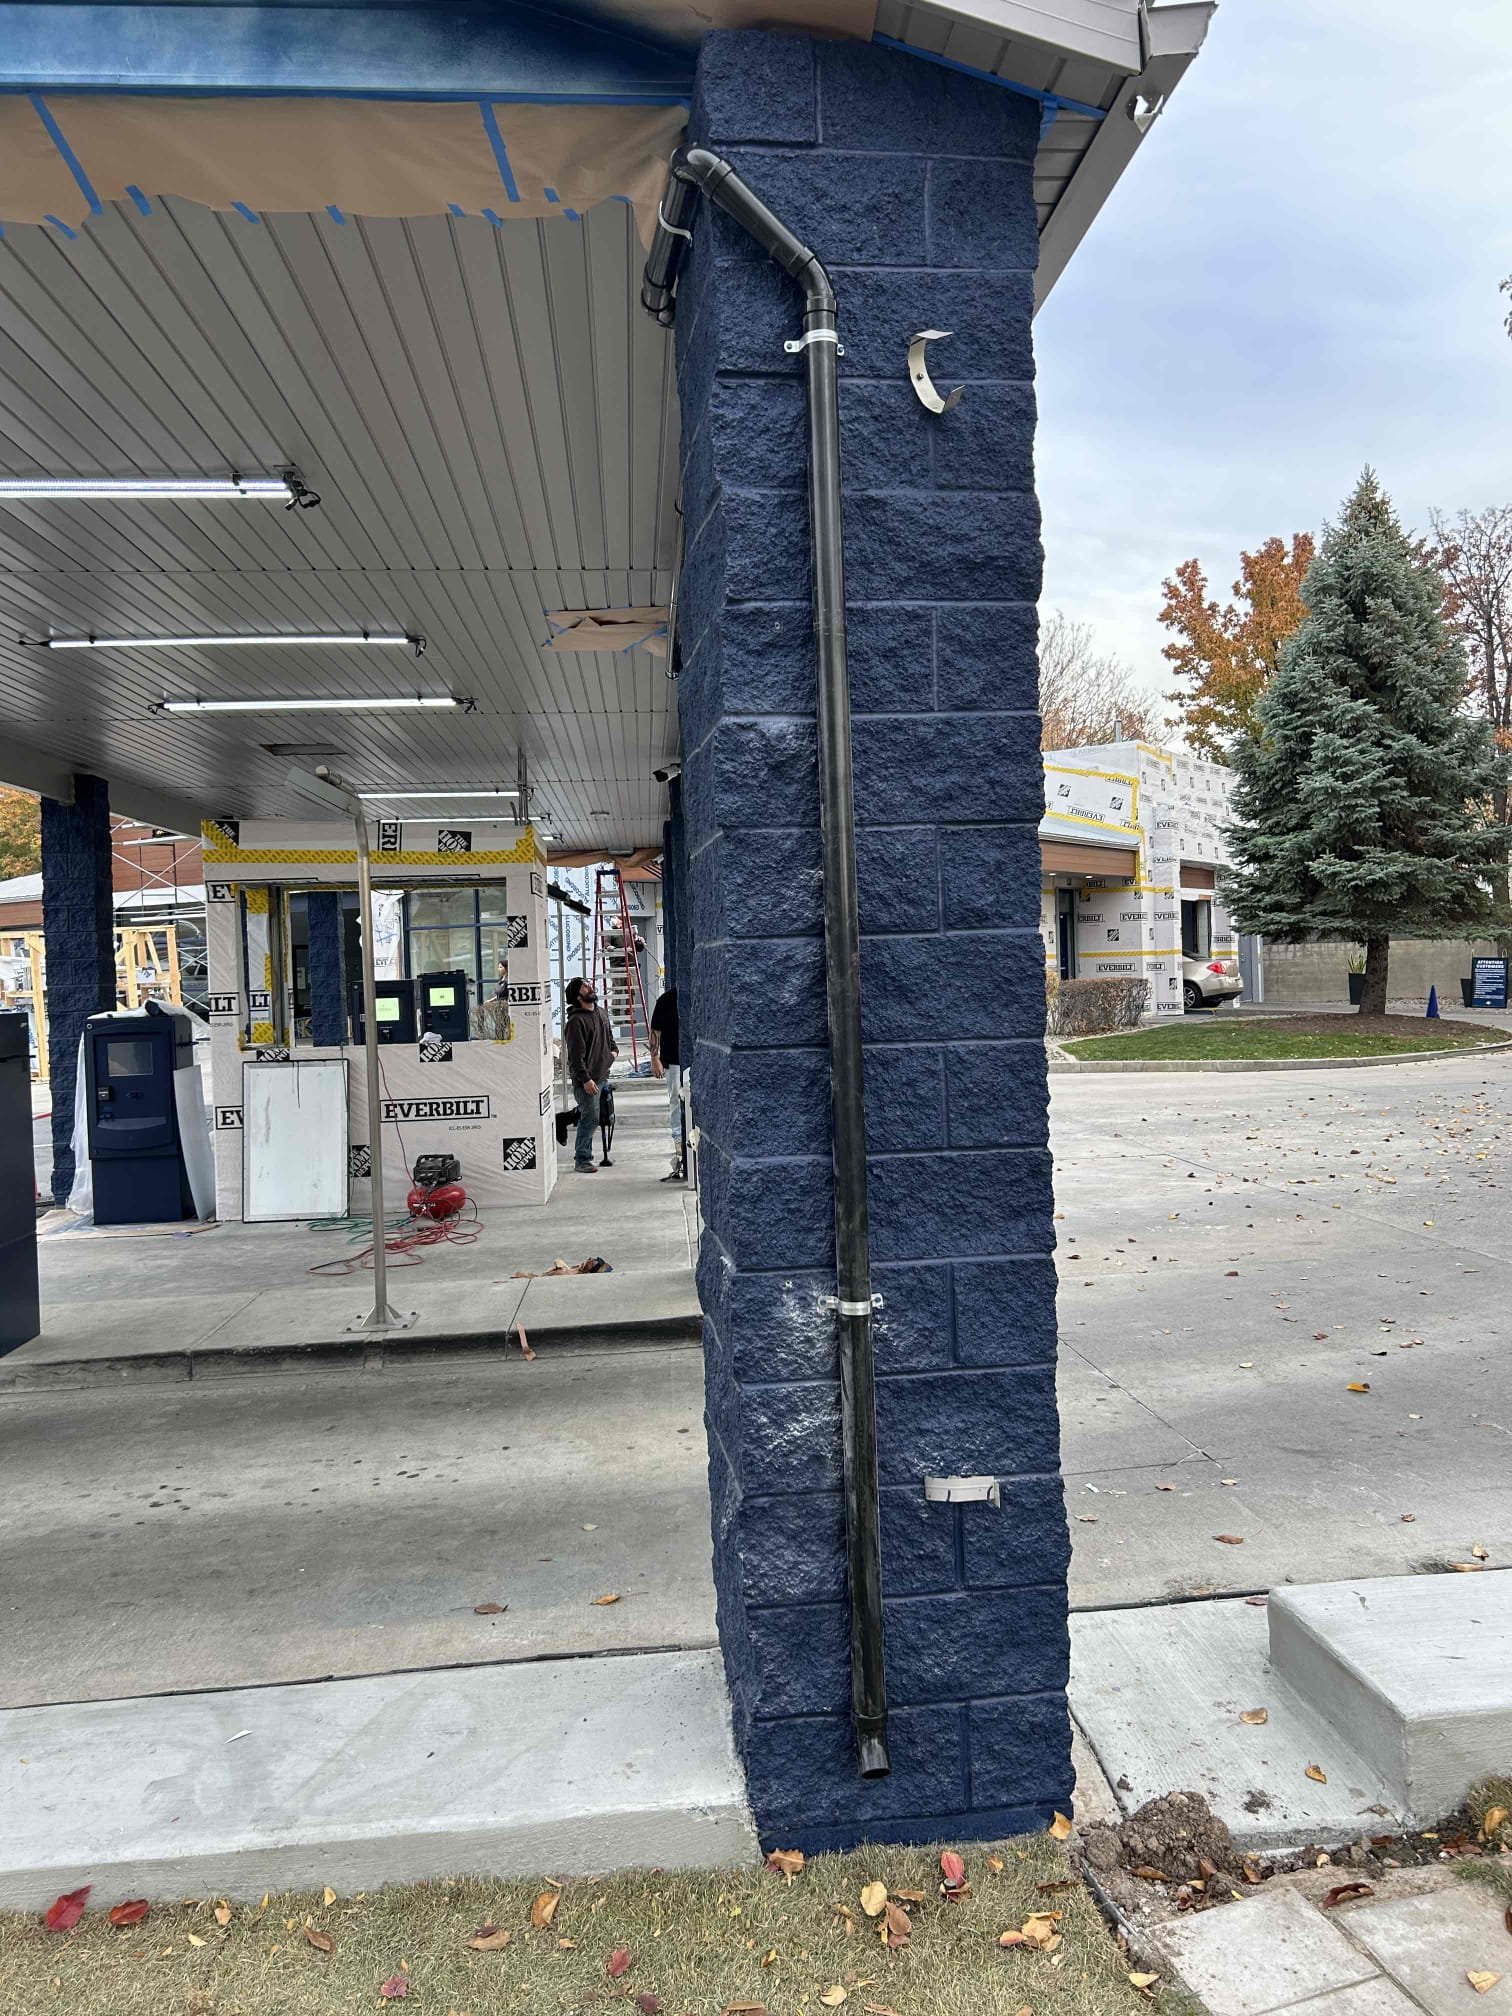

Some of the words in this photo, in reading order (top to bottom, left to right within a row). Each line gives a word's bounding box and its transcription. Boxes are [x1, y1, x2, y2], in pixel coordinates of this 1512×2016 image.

[381, 823, 398, 850] ER
[1098, 963, 1133, 971] EVERBILT
[384, 1100, 485, 1119] EVERBILT
[504, 1137, 535, 1170] HOME
[506, 1141, 519, 1154] THE
[516, 1149, 536, 1170] DEPOT
